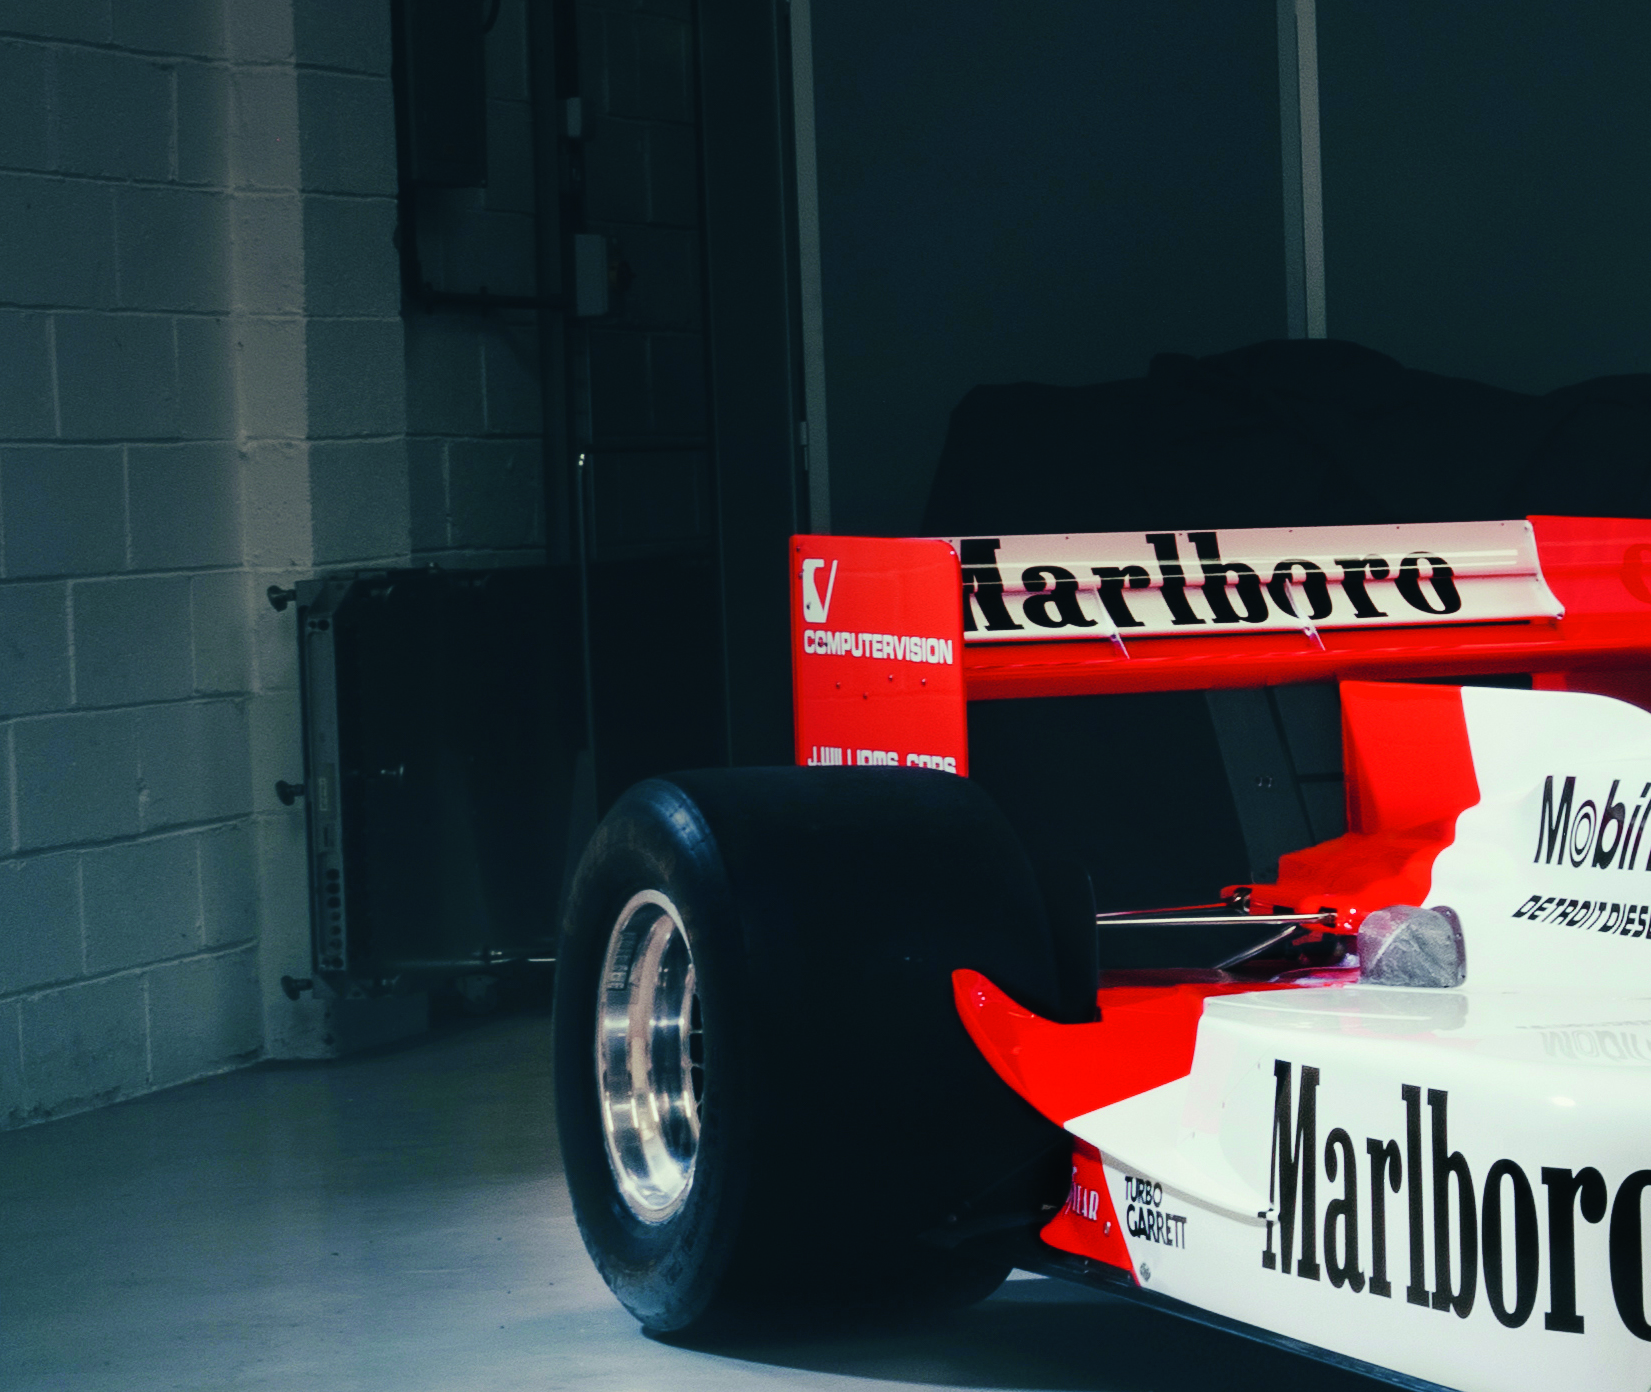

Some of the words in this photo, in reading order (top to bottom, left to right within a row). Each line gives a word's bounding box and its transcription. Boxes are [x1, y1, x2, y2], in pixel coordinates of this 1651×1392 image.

[960, 532, 1463, 632] Marlboro
[803, 629, 954, 665] COMPUTERVISION
[1124, 1176, 1163, 1208] TURBO
[1126, 1204, 1187, 1250] GARRETT
